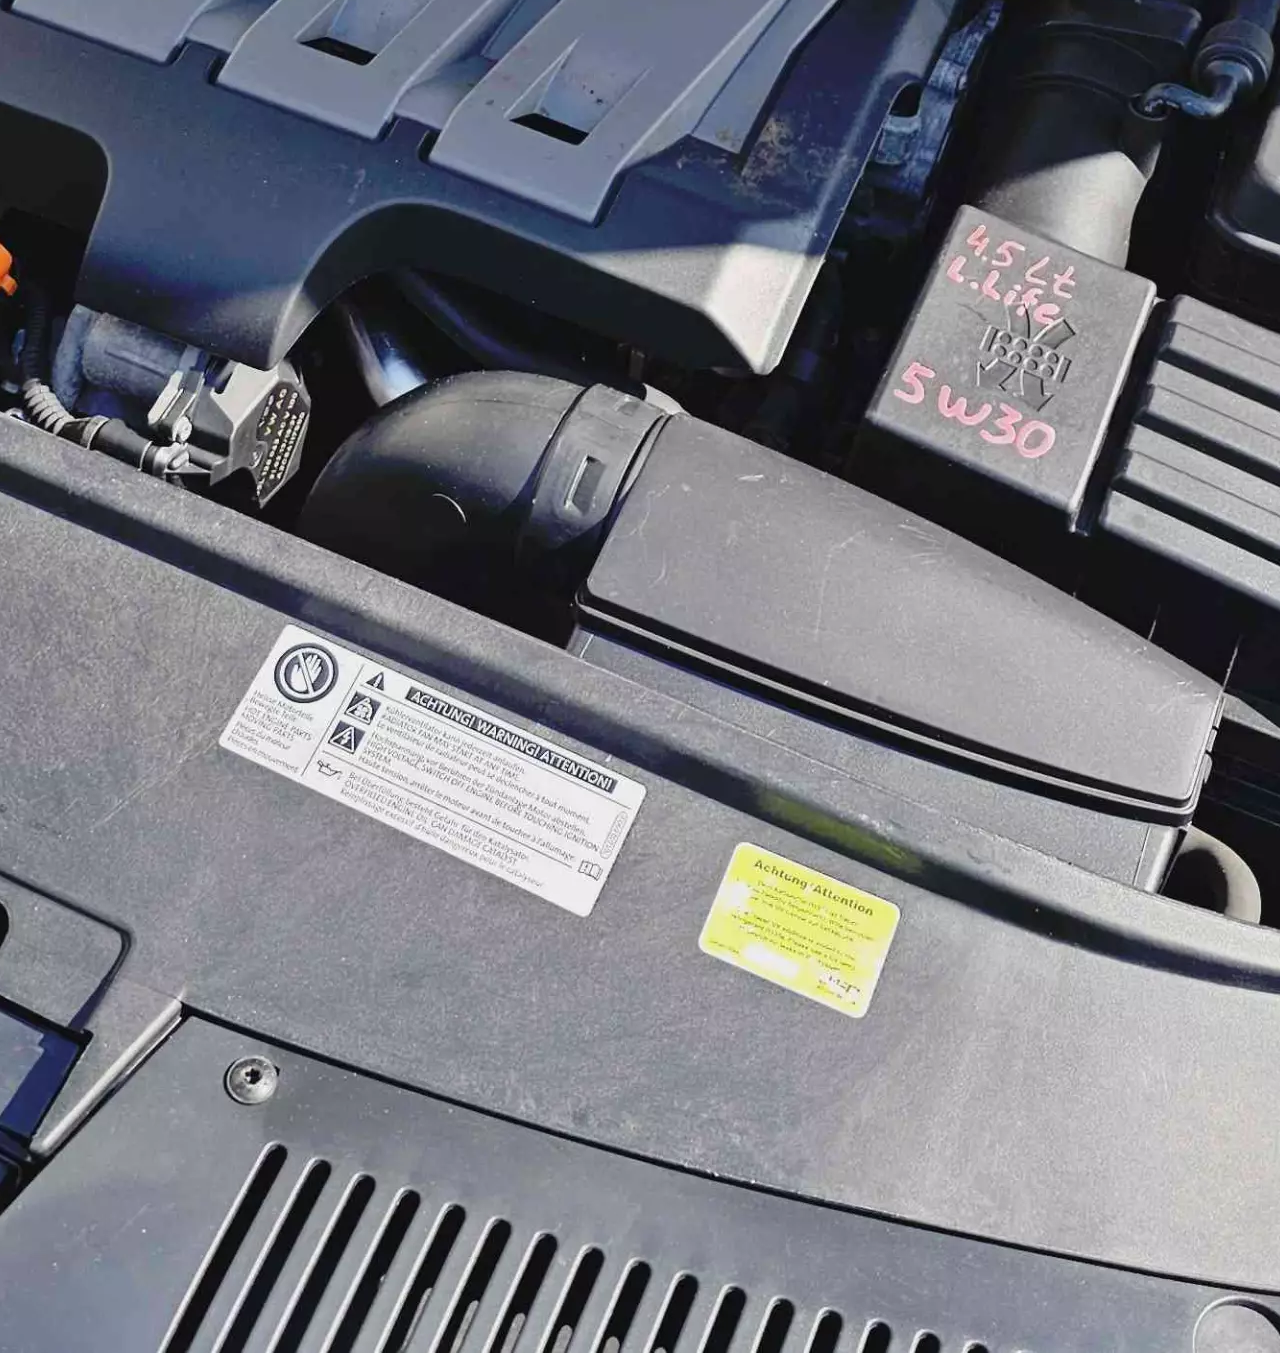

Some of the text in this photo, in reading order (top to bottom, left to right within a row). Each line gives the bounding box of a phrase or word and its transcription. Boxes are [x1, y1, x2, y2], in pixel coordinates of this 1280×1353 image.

[967, 224, 1025, 267] 4.5
[408, 689, 614, 790] ACHTUNG! WARNING! ATTENTION!
